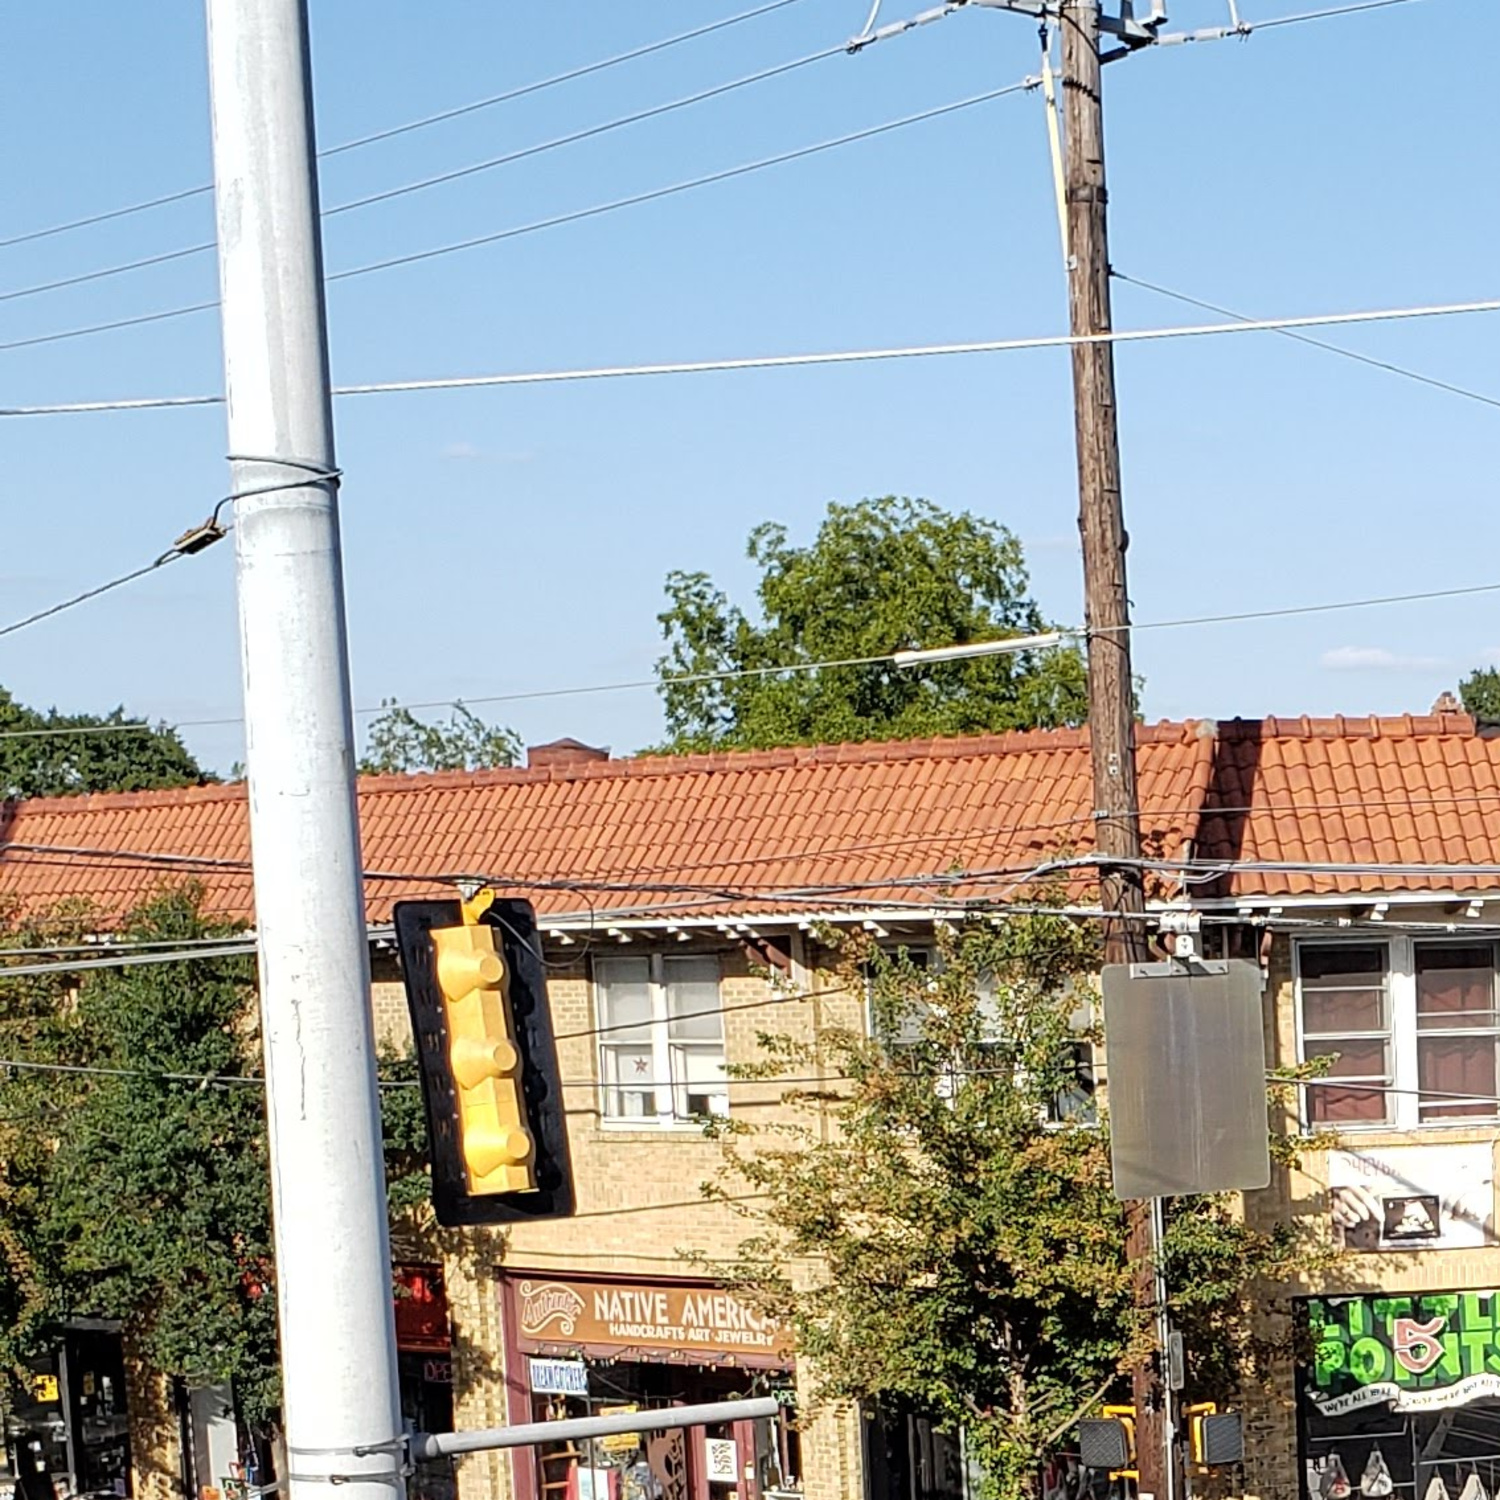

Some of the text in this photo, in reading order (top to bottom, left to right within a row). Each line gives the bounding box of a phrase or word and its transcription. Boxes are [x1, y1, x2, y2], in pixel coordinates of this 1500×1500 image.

[593, 1290, 669, 1325] NATIVE
[681, 1294, 791, 1333] AMERICA
[609, 1323, 775, 1347] HANDCRAFTS ART JEWELRY
[1393, 1316, 1447, 1374] 5
[771, 1389, 796, 1404] OPE
